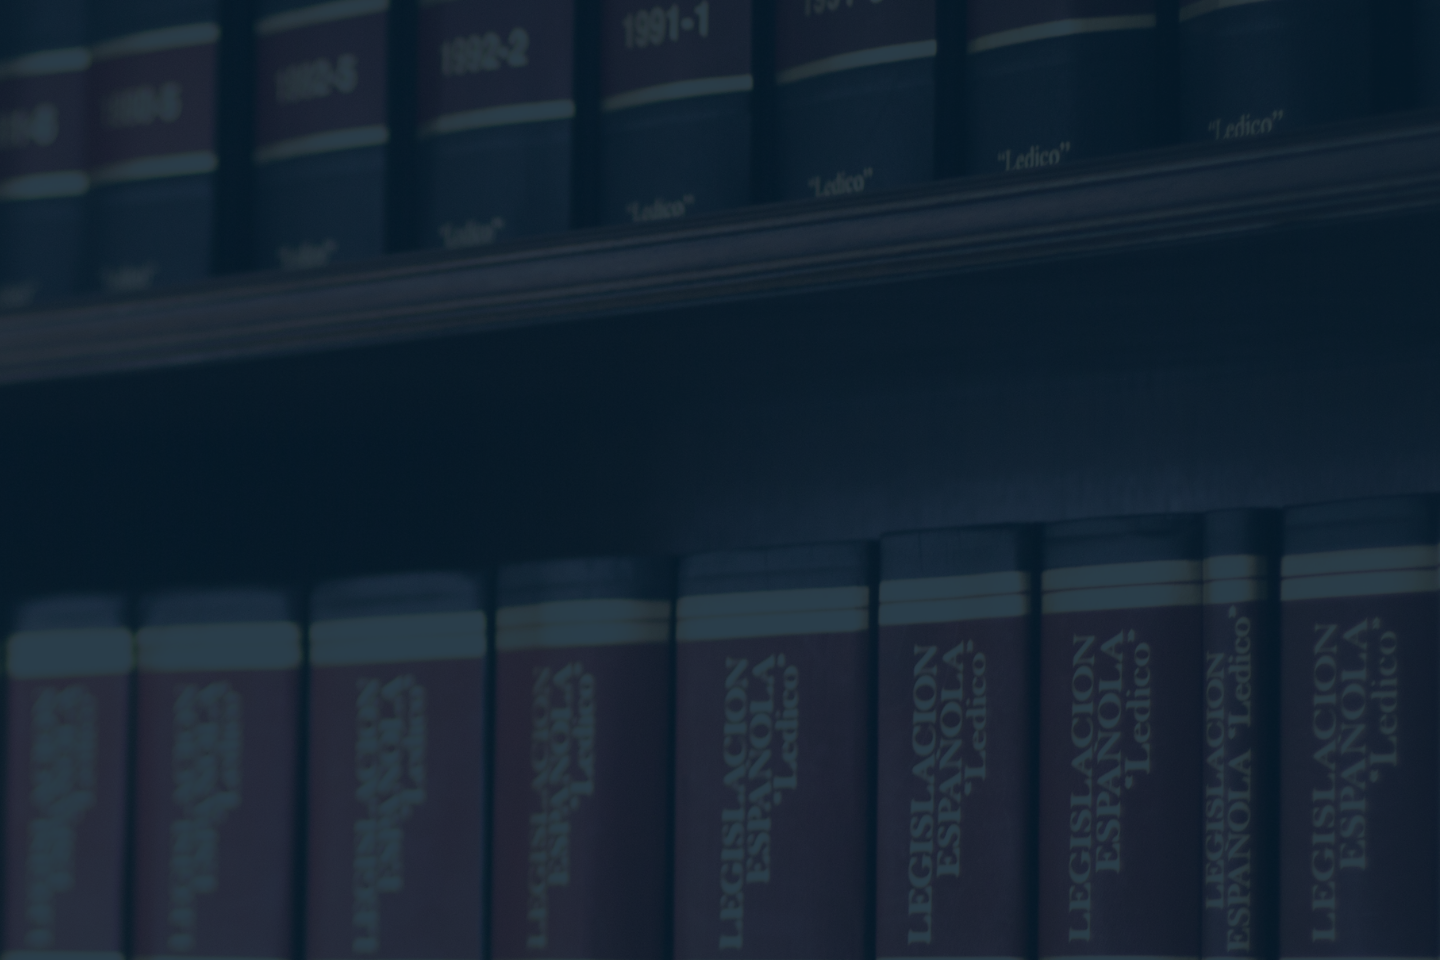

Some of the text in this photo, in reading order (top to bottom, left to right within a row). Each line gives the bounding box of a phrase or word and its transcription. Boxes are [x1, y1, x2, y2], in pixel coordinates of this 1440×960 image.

[440, 27, 530, 77] 1992-2
[622, 1, 710, 49] 1991-1
[718, 656, 749, 950] LEGISLACION
[746, 653, 776, 884] ESPAÑOLA
[907, 644, 938, 945] LEGISLACION
[936, 640, 964, 878] ESPAÑOLA
[1068, 632, 1096, 943] LEGISLACION
[1094, 629, 1124, 874] ESPAÑOLA
[1205, 651, 1225, 910] LEGISLACION
[1225, 748, 1251, 952] ESPAÑOLA
[1312, 622, 1338, 943] LEGISLACION
[1338, 617, 1369, 871] ESPAÑOLA
